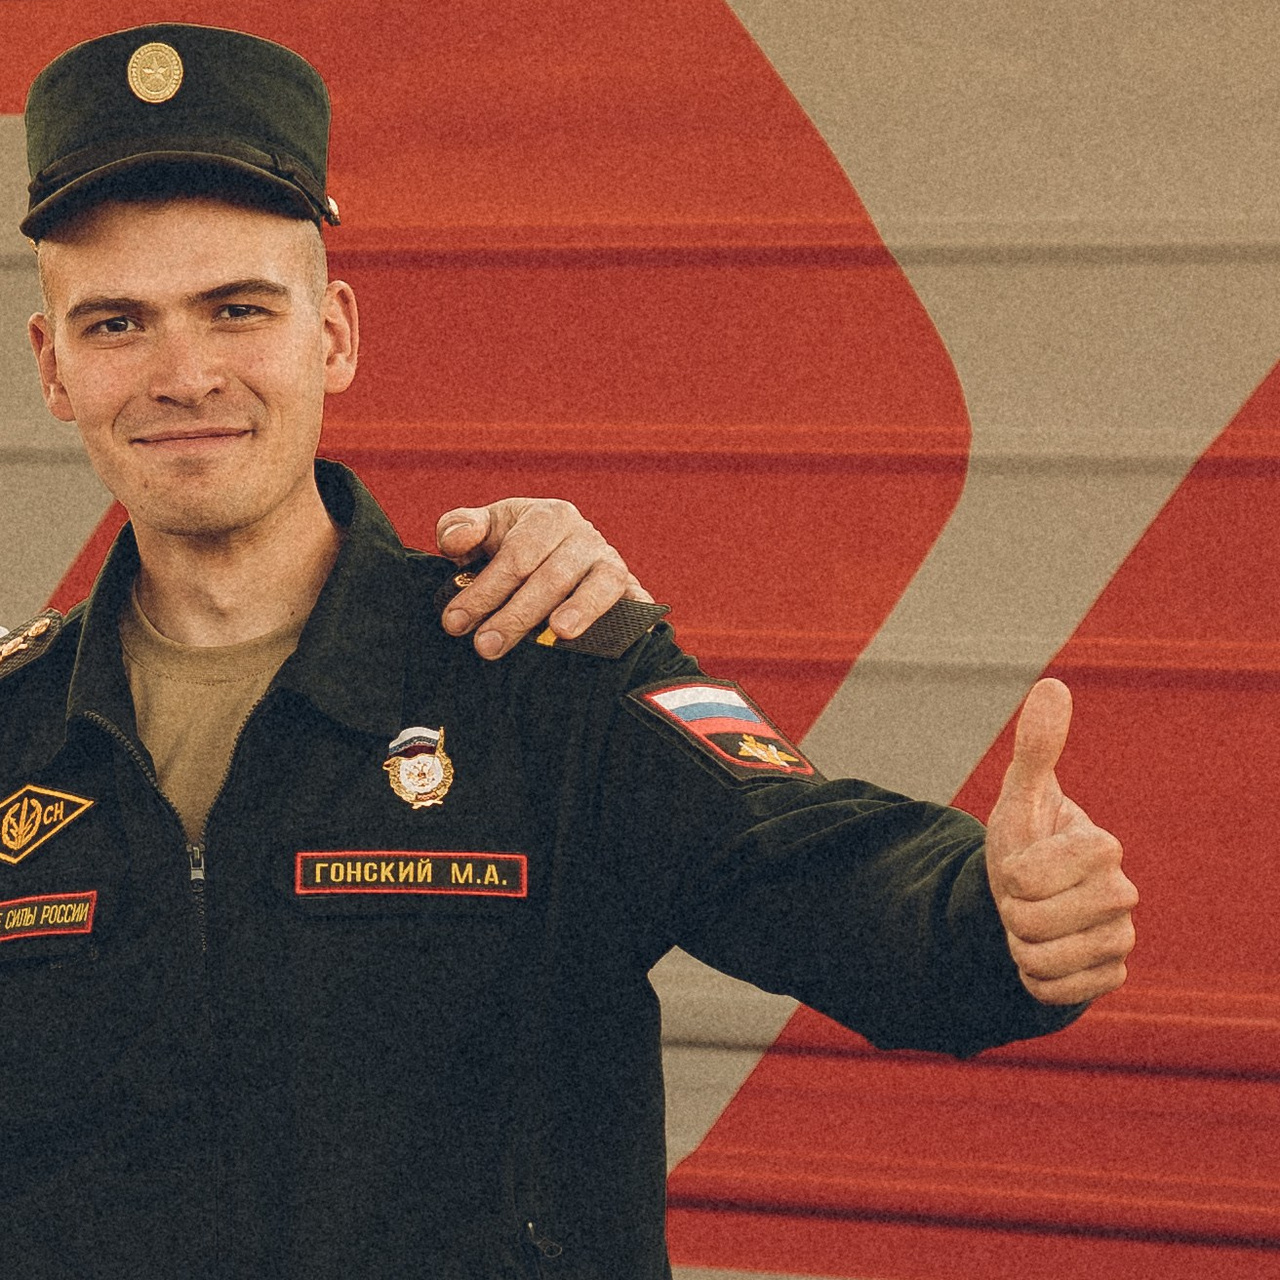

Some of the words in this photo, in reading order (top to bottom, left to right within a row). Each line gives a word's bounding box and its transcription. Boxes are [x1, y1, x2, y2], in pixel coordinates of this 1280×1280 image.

[44, 801, 64, 824] СН
[315, 858, 432, 883] ГОНСКИЙ
[451, 863, 508, 885] М.А.
[5, 907, 38, 930] СИЛЫ
[40, 903, 90, 923] РОССИИ
